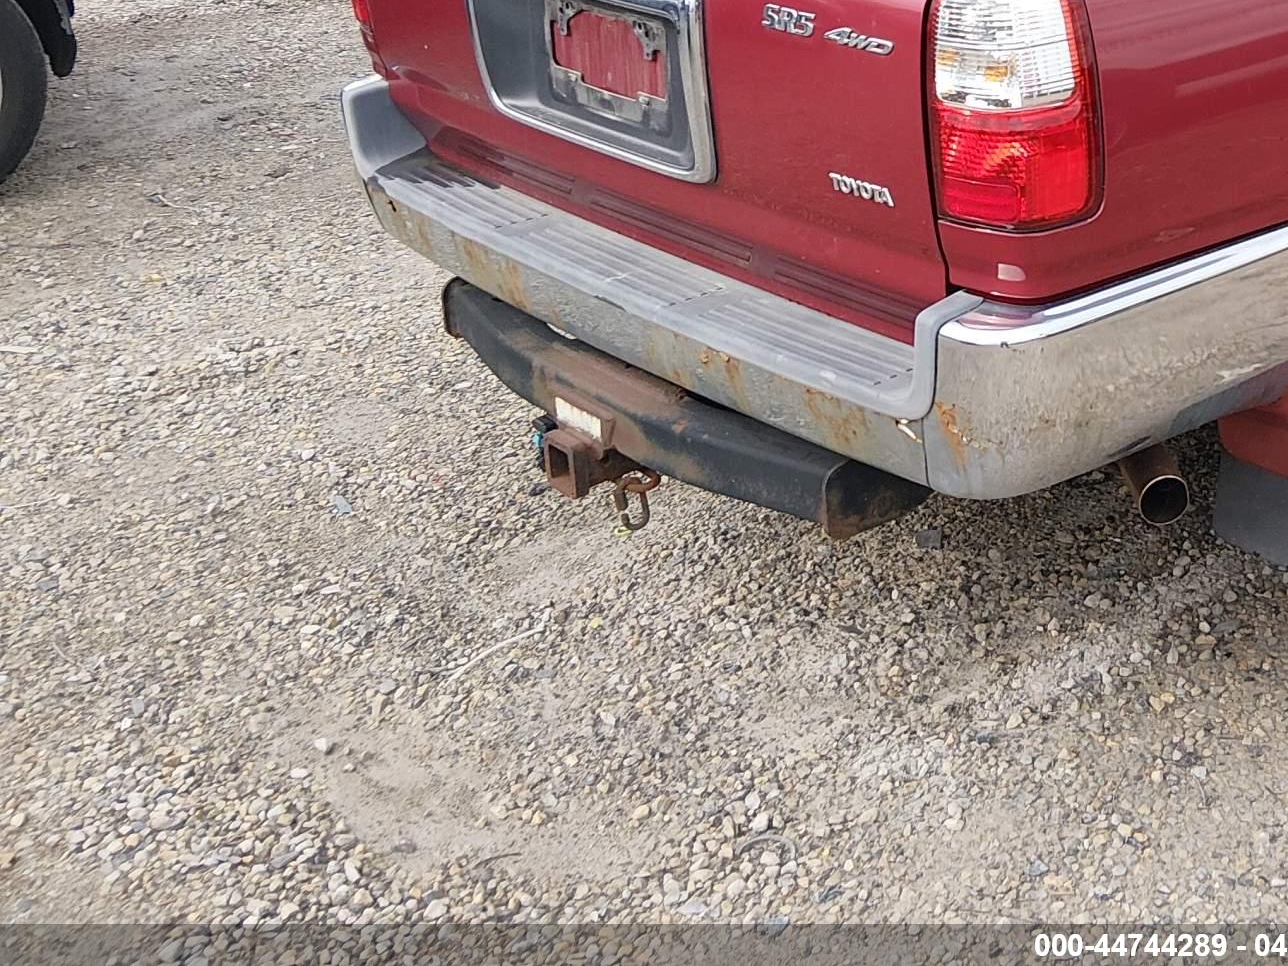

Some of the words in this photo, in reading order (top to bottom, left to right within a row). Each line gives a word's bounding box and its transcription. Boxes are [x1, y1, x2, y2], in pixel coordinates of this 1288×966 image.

[761, 3, 816, 37] SR5
[823, 26, 894, 55] 4WD
[828, 172, 895, 207] TOYOTA
